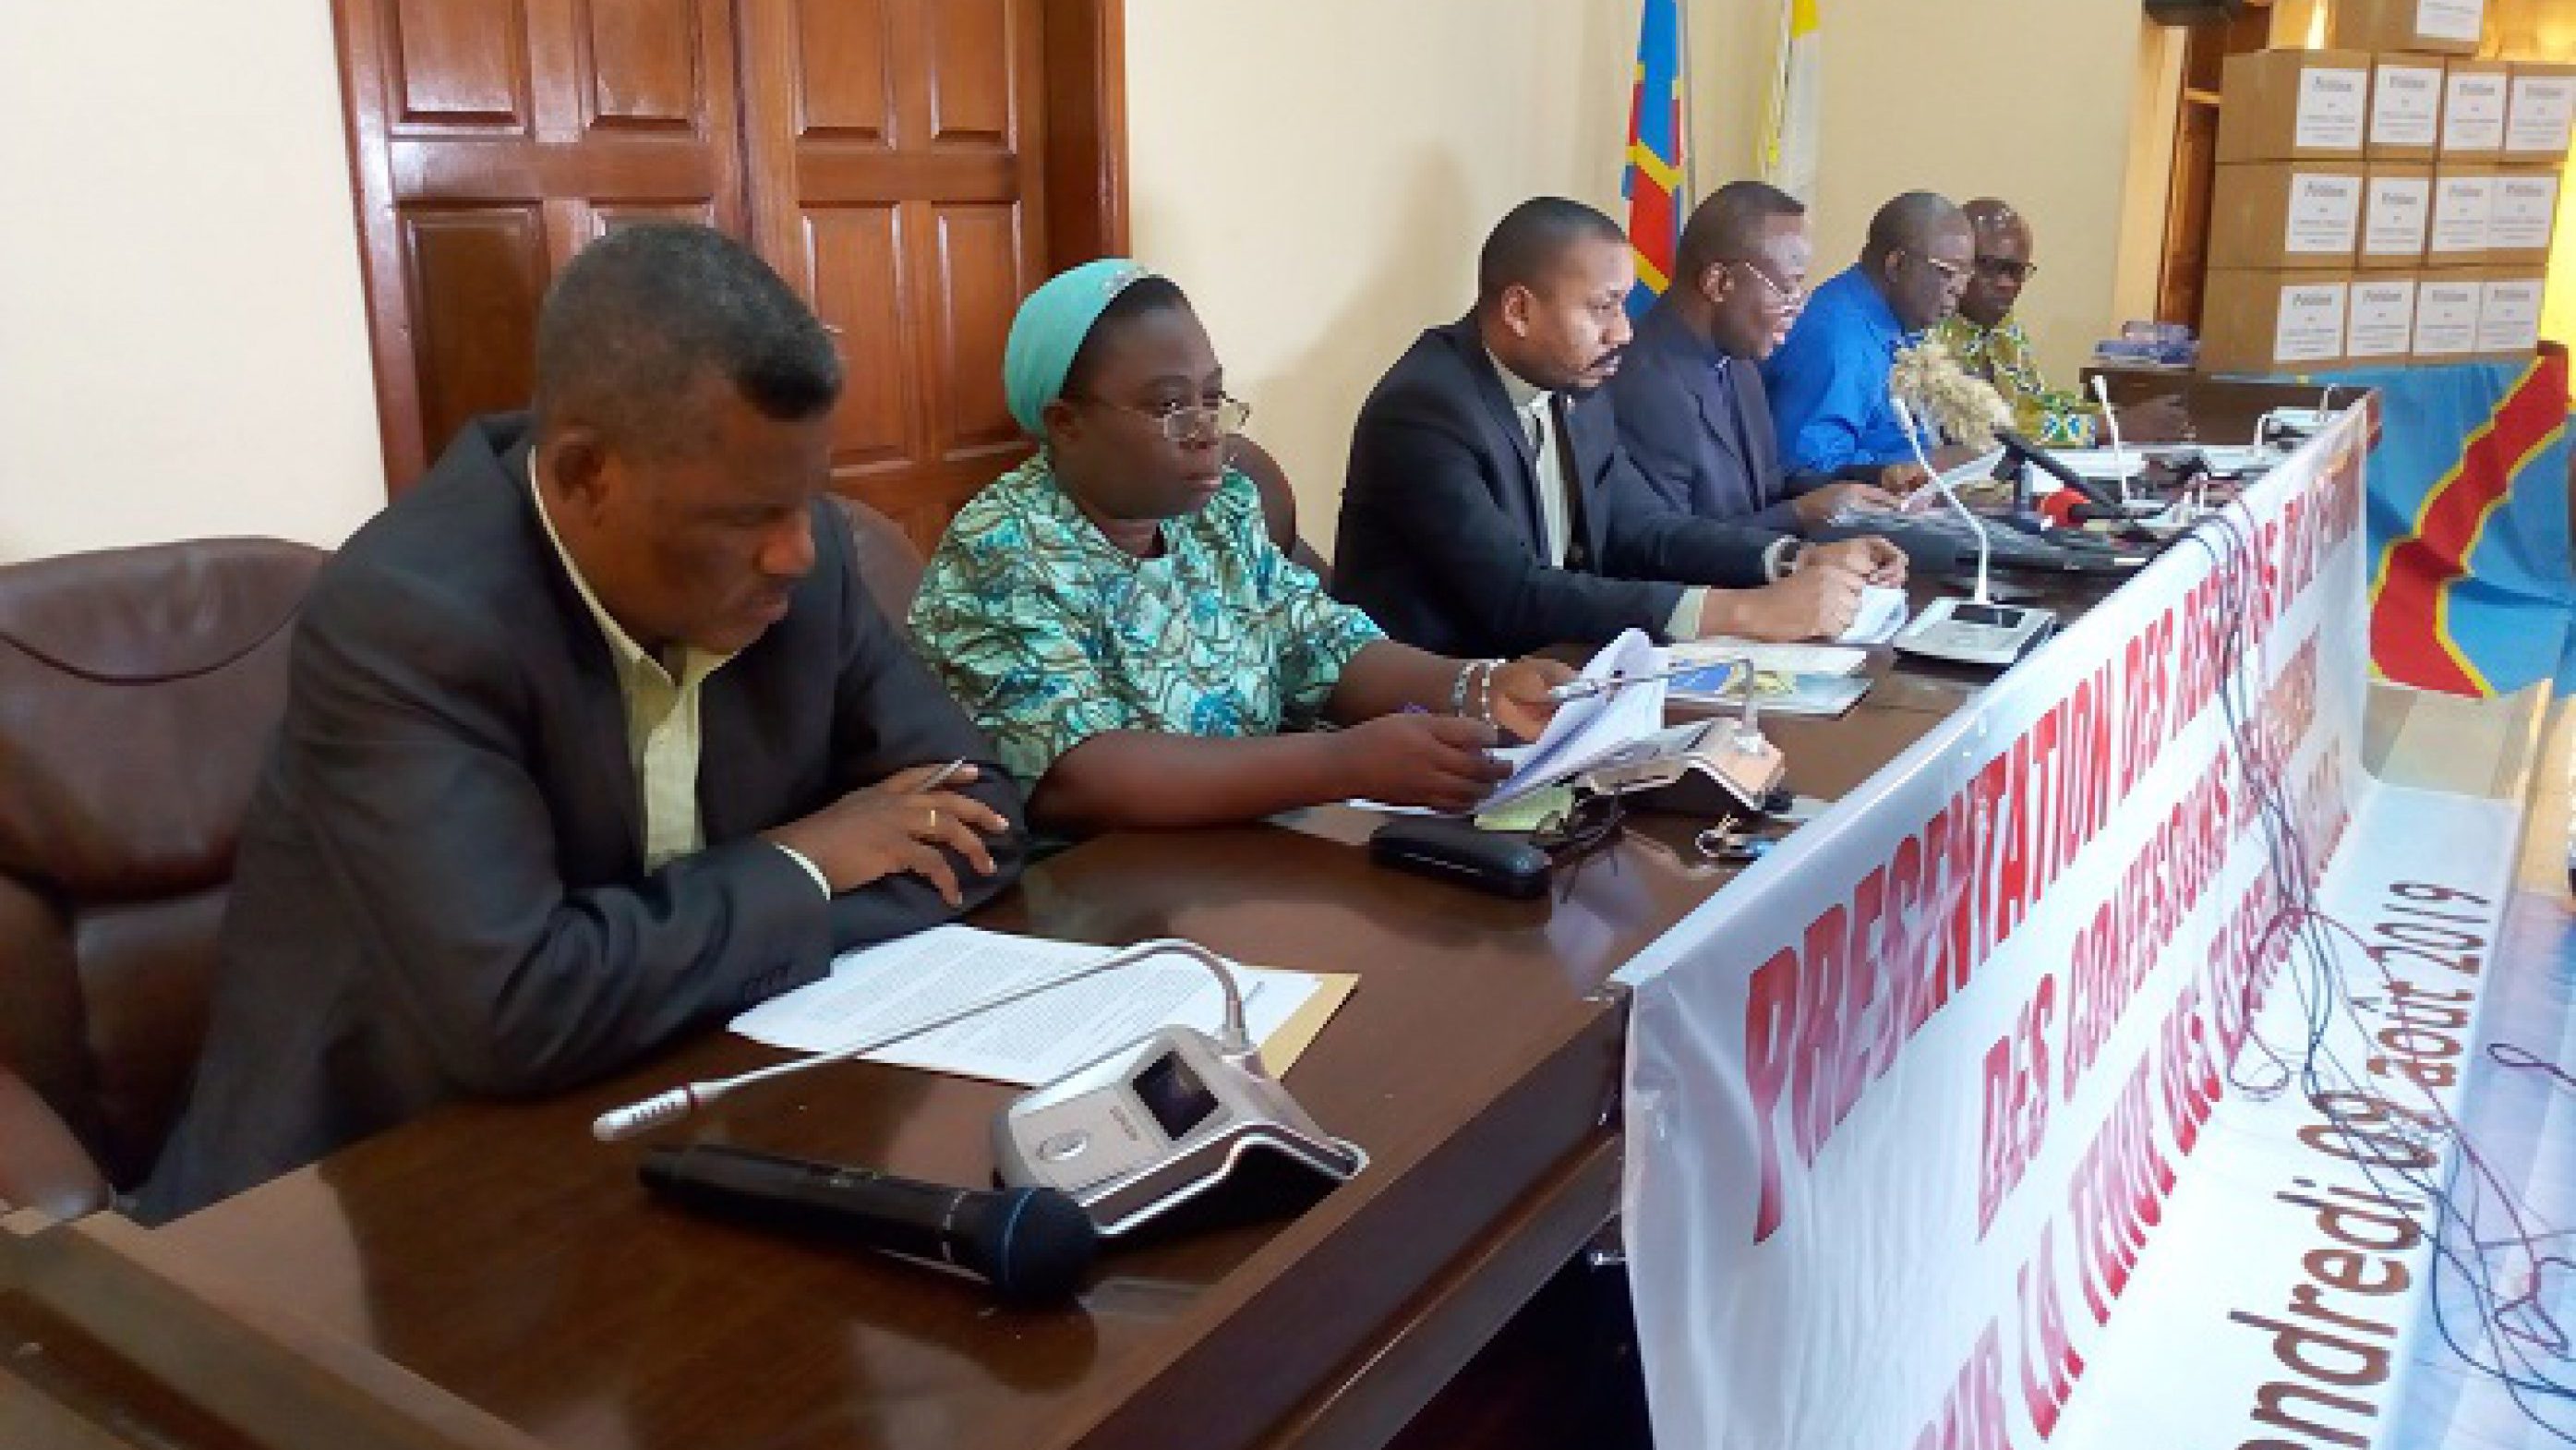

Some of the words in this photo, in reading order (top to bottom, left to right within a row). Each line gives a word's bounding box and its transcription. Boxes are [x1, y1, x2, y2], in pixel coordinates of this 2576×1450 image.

[1744, 659, 2111, 1244] PRESENTATION
[2118, 608, 2173, 806] DES
[2348, 981, 2476, 1088] août
[2365, 879, 2491, 977] 2019
[1976, 973, 2057, 1242] DES
[2016, 1213, 2085, 1443] LA
[2225, 1176, 2428, 1450] ndredi
